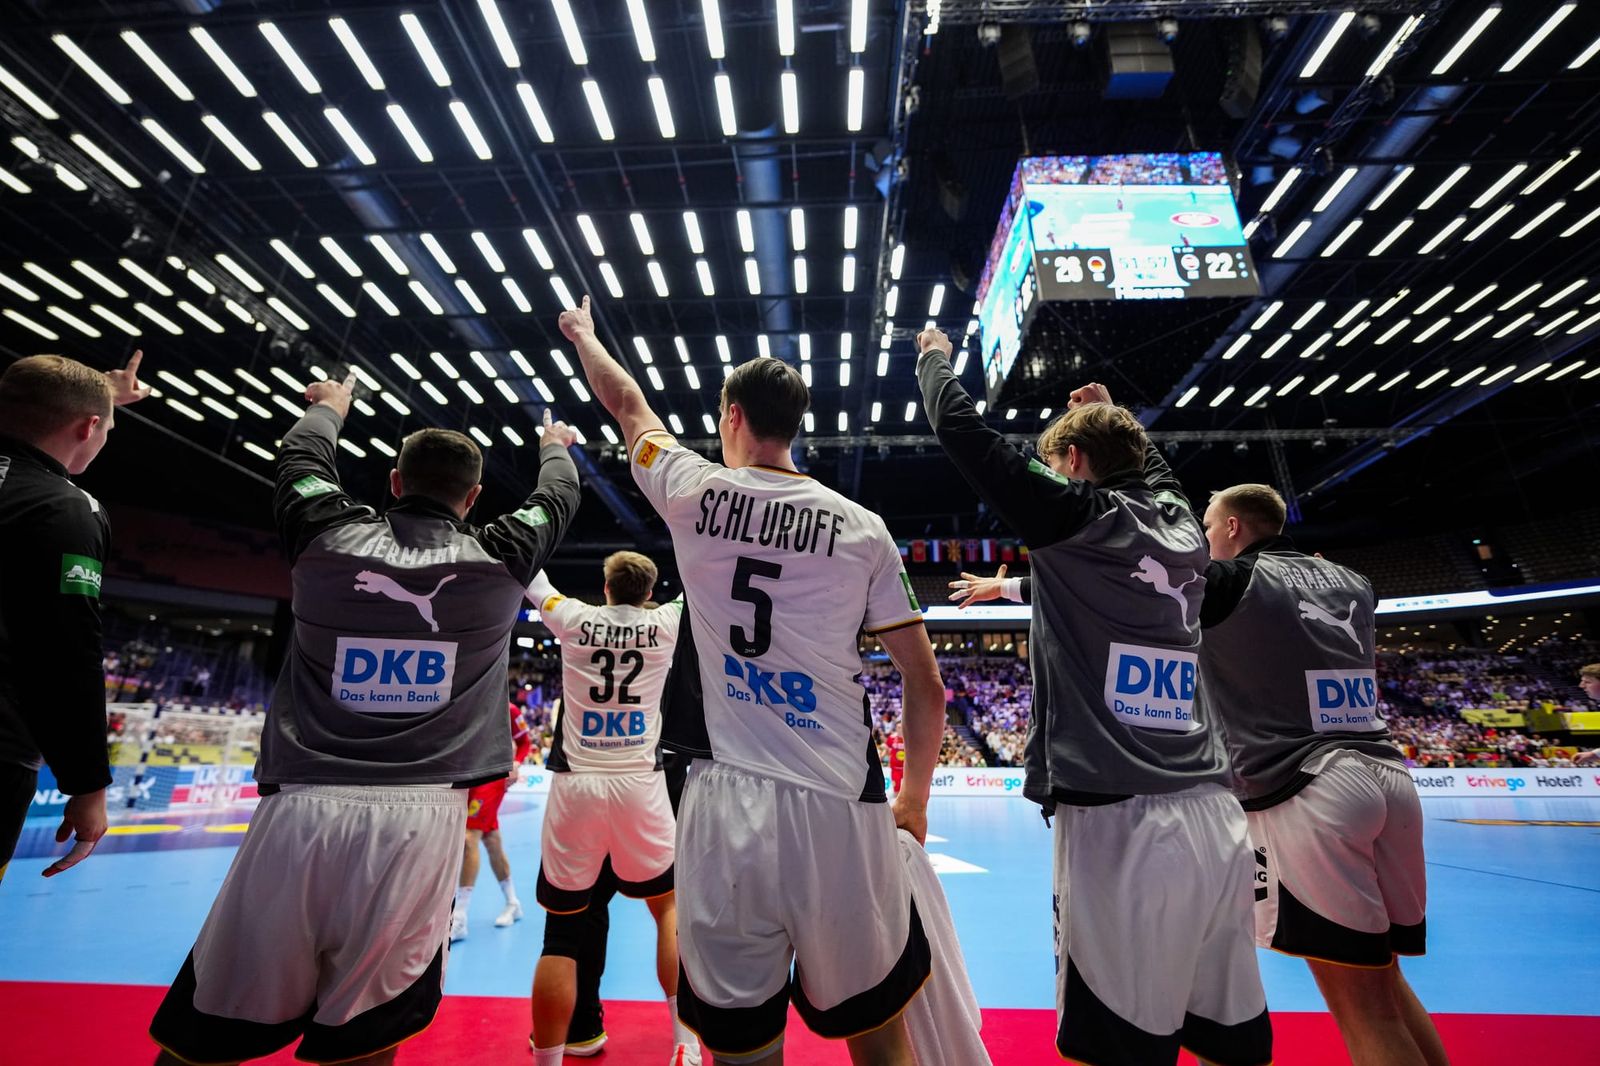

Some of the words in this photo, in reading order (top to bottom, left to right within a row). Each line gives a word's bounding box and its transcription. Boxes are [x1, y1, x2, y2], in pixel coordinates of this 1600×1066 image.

[1204, 252, 1238, 279] 22
[695, 488, 845, 558] SCHLUROFF
[730, 555, 783, 658] 5
[578, 620, 659, 649] SEMPER
[341, 648, 446, 685] DKB
[589, 648, 645, 704] 32
[1115, 653, 1195, 701] DKB
[340, 688, 365, 702] Das
[369, 689, 403, 703] kann
[406, 690, 440, 703] Bank
[727, 682, 751, 702] Das
[1316, 677, 1376, 709] DKB
[1114, 699, 1140, 716] Das
[1144, 703, 1172, 719] kann
[1320, 713, 1344, 724] Das
[1346, 712, 1368, 723] kann
[580, 710, 647, 737] DKB
[580, 738, 598, 748] Das
[599, 739, 622, 748] kann
[624, 737, 646, 747] Bank
[966, 774, 1022, 791] trivago
[1466, 774, 1526, 791] trivago
[1535, 775, 1584, 788] Hotel?
